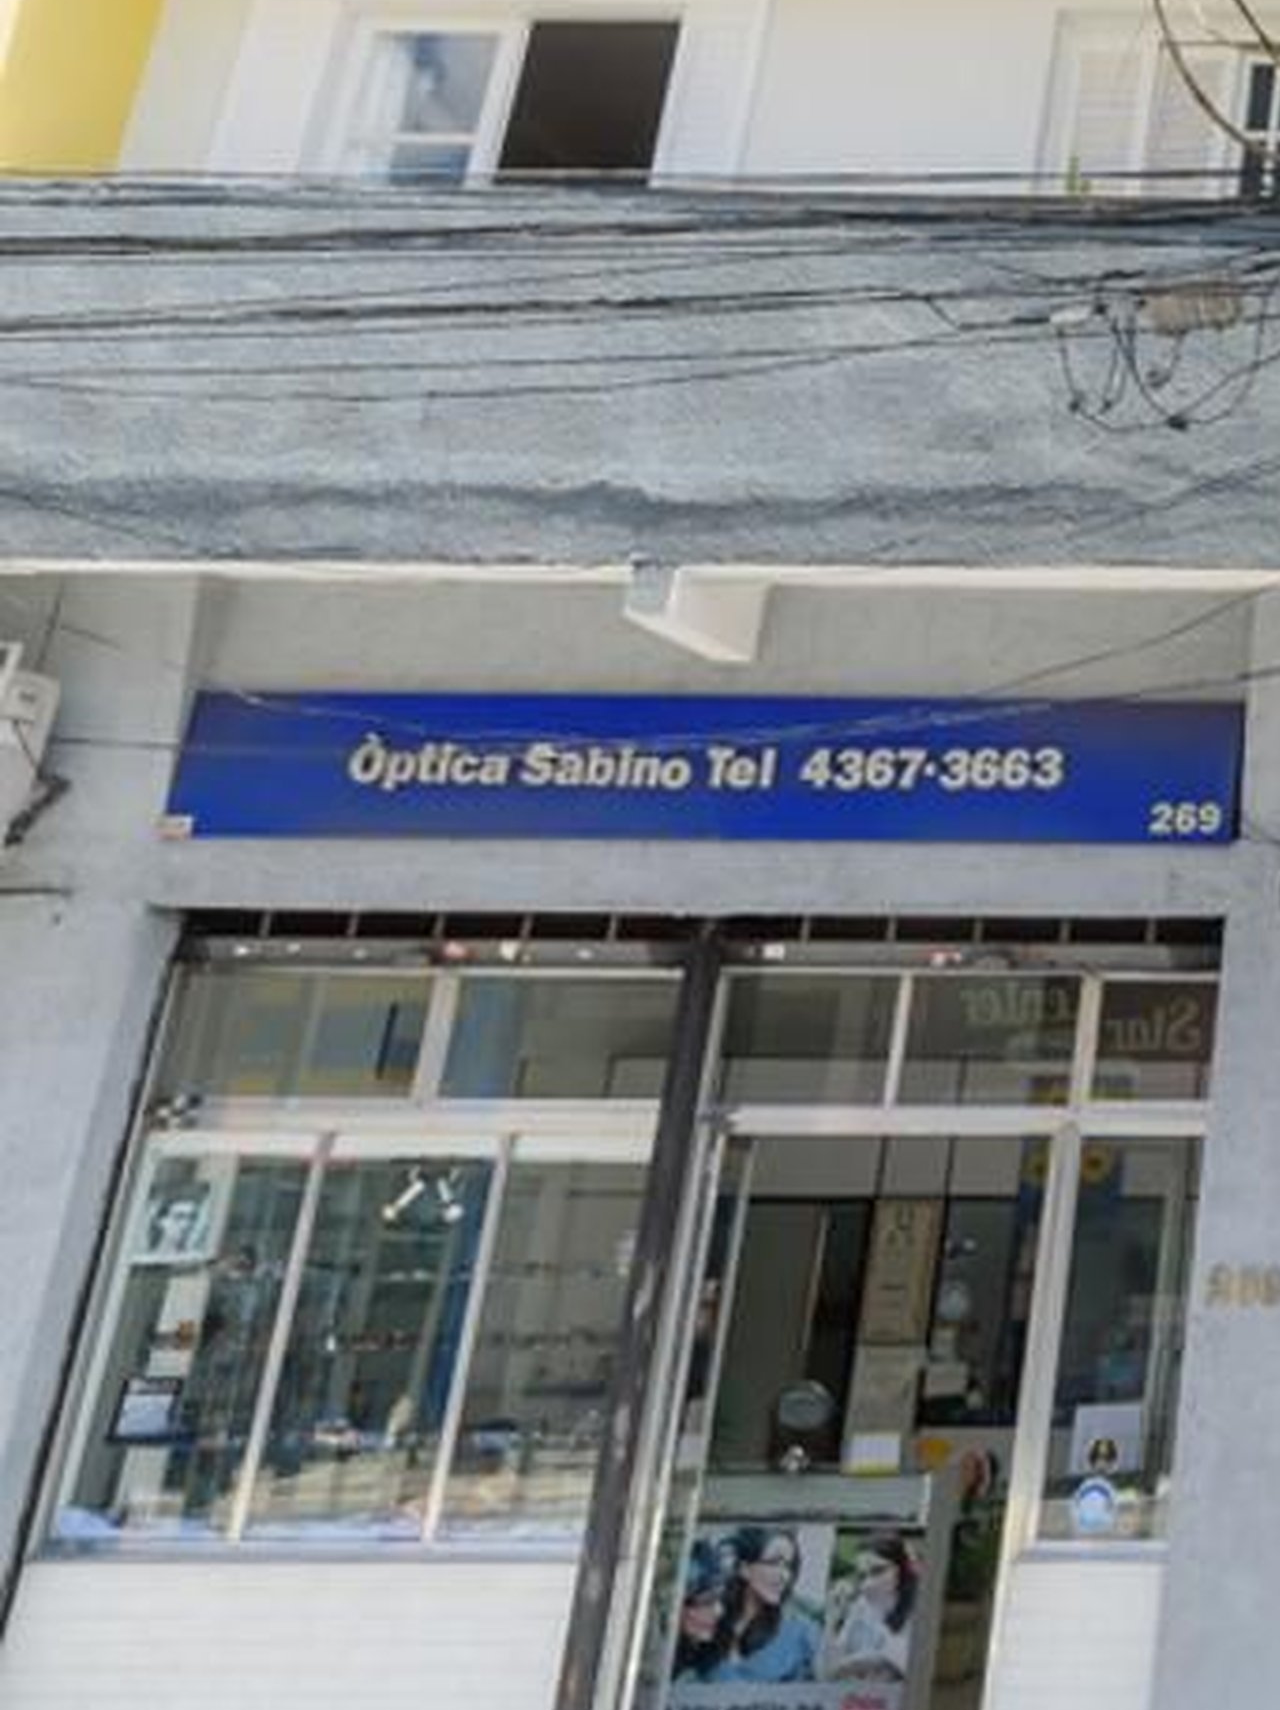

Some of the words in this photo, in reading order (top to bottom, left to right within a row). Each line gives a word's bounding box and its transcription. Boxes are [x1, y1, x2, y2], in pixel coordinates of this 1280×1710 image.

[519, 741, 692, 790] Sabino
[707, 746, 777, 788] Tel
[1149, 803, 1221, 833] 269
